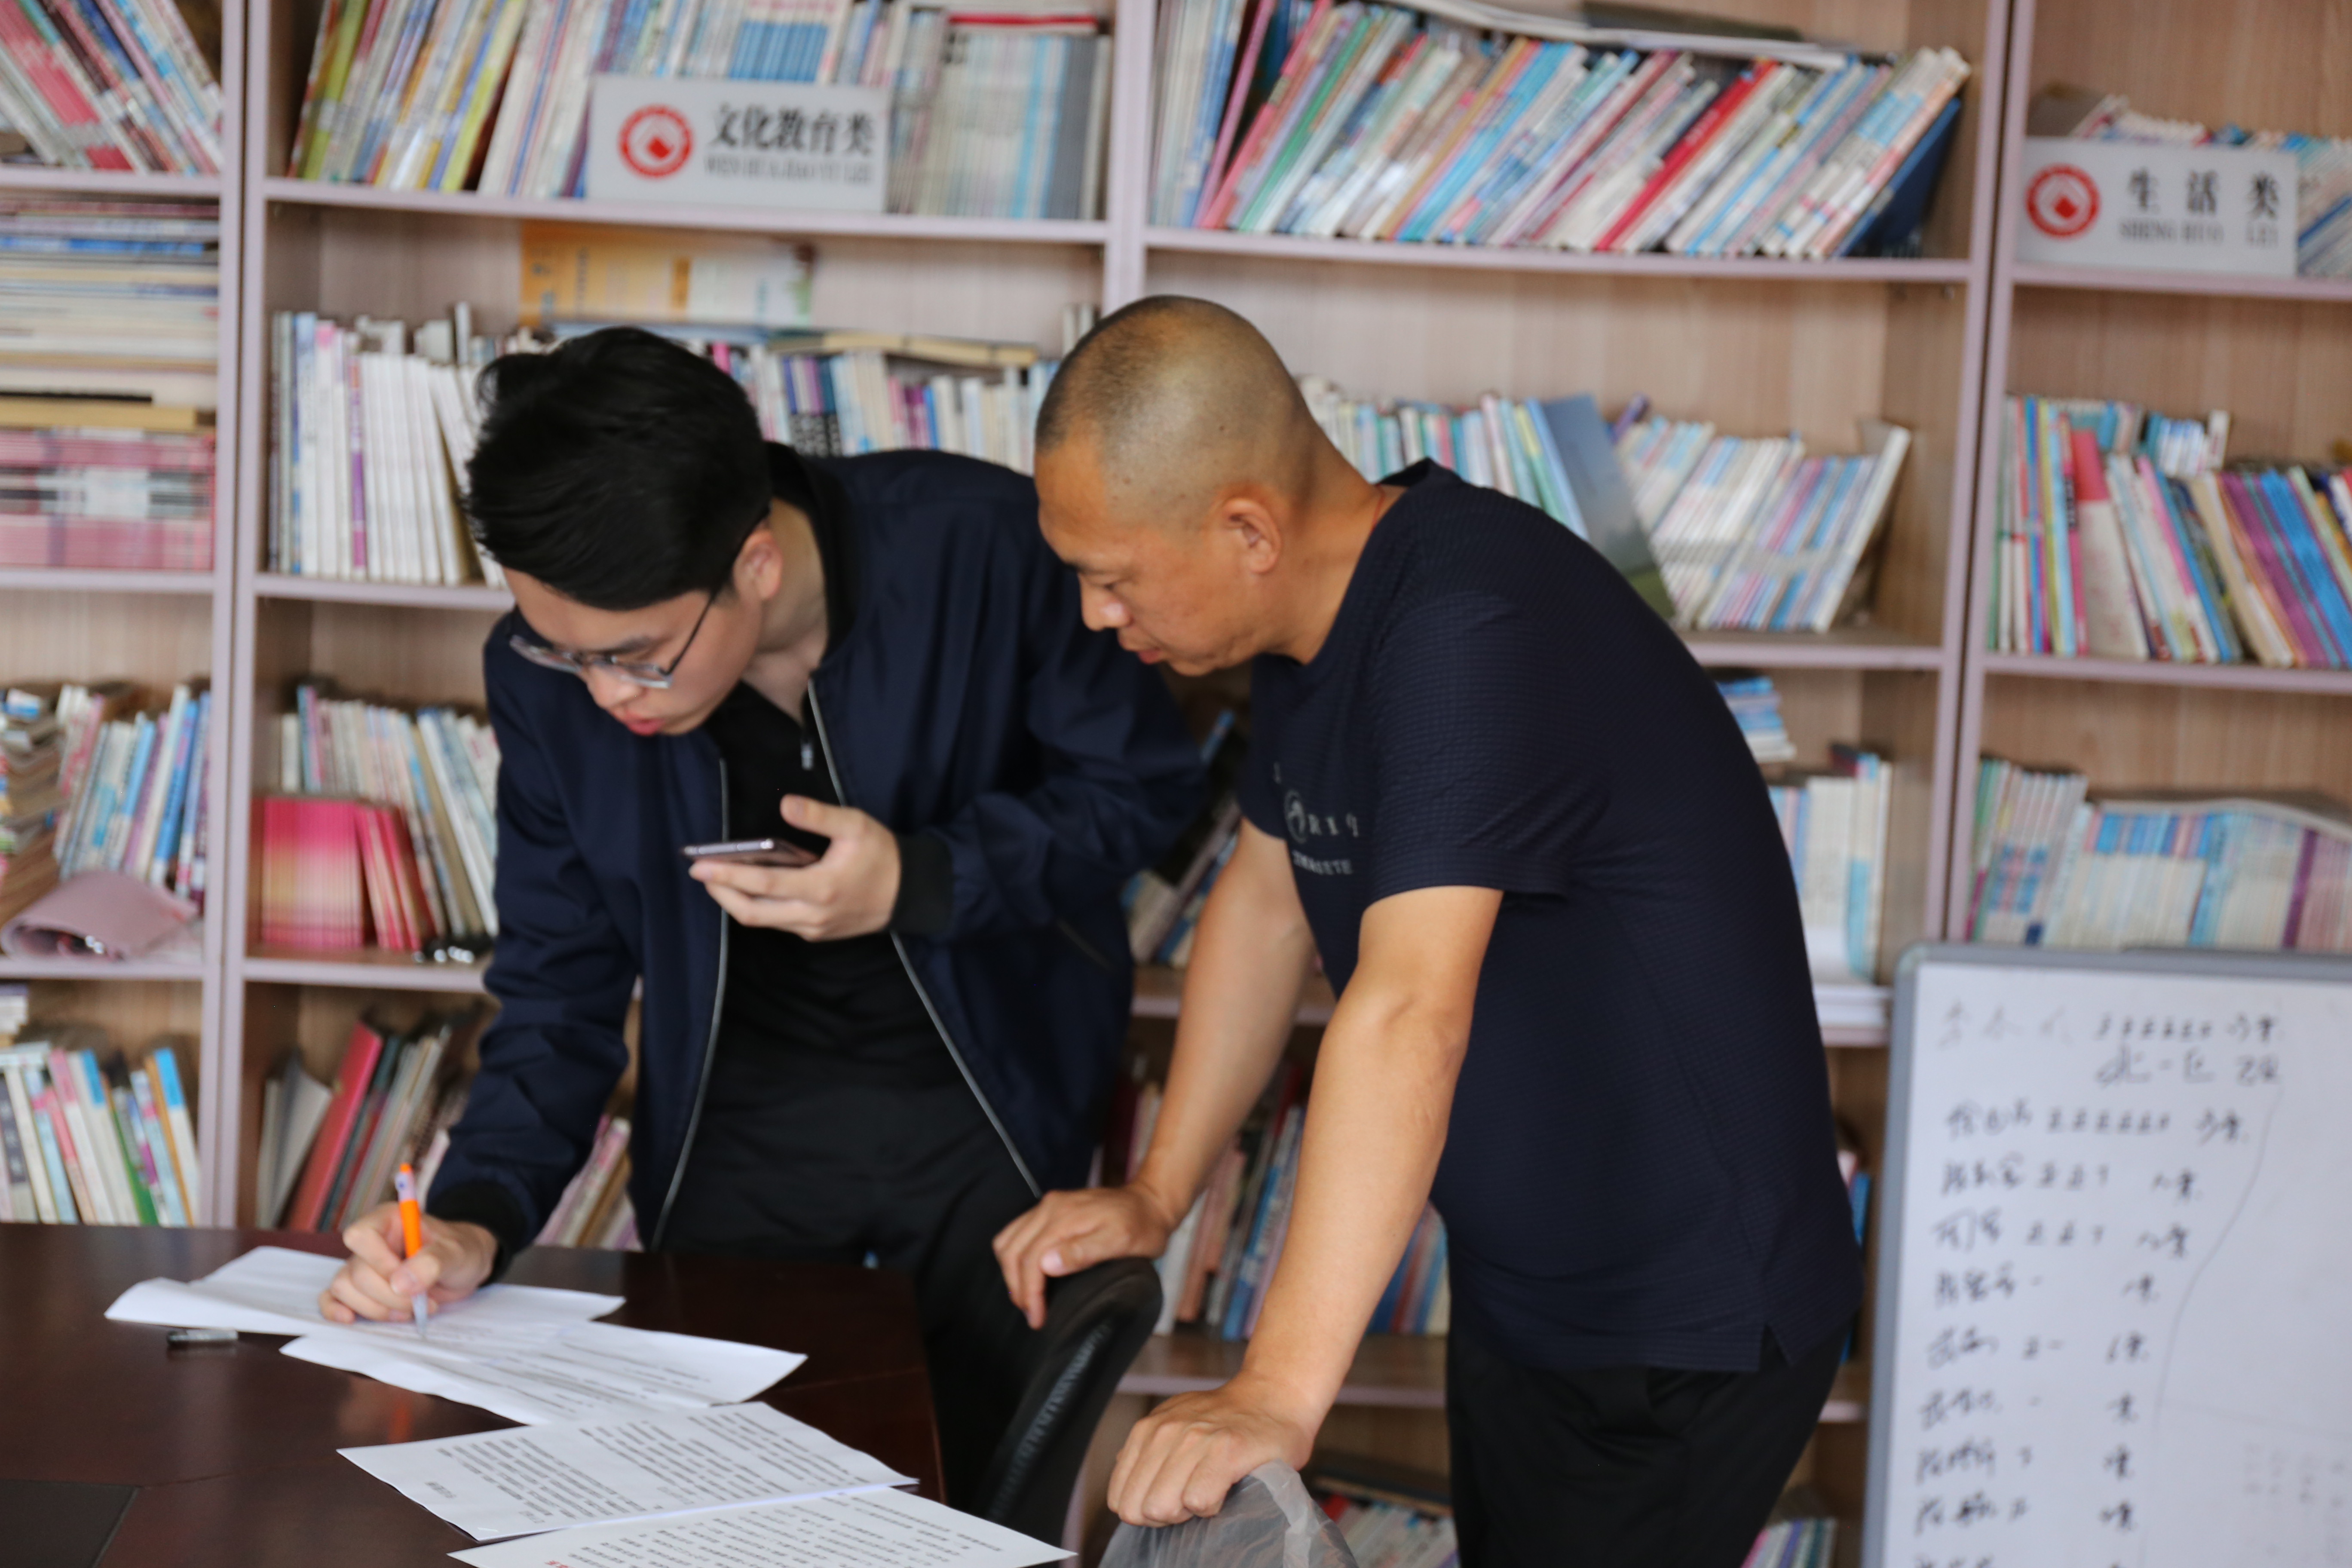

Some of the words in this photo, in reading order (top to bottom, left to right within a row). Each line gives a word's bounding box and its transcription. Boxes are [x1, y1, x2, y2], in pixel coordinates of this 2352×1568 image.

[708, 103, 873, 156] 文化教育类
